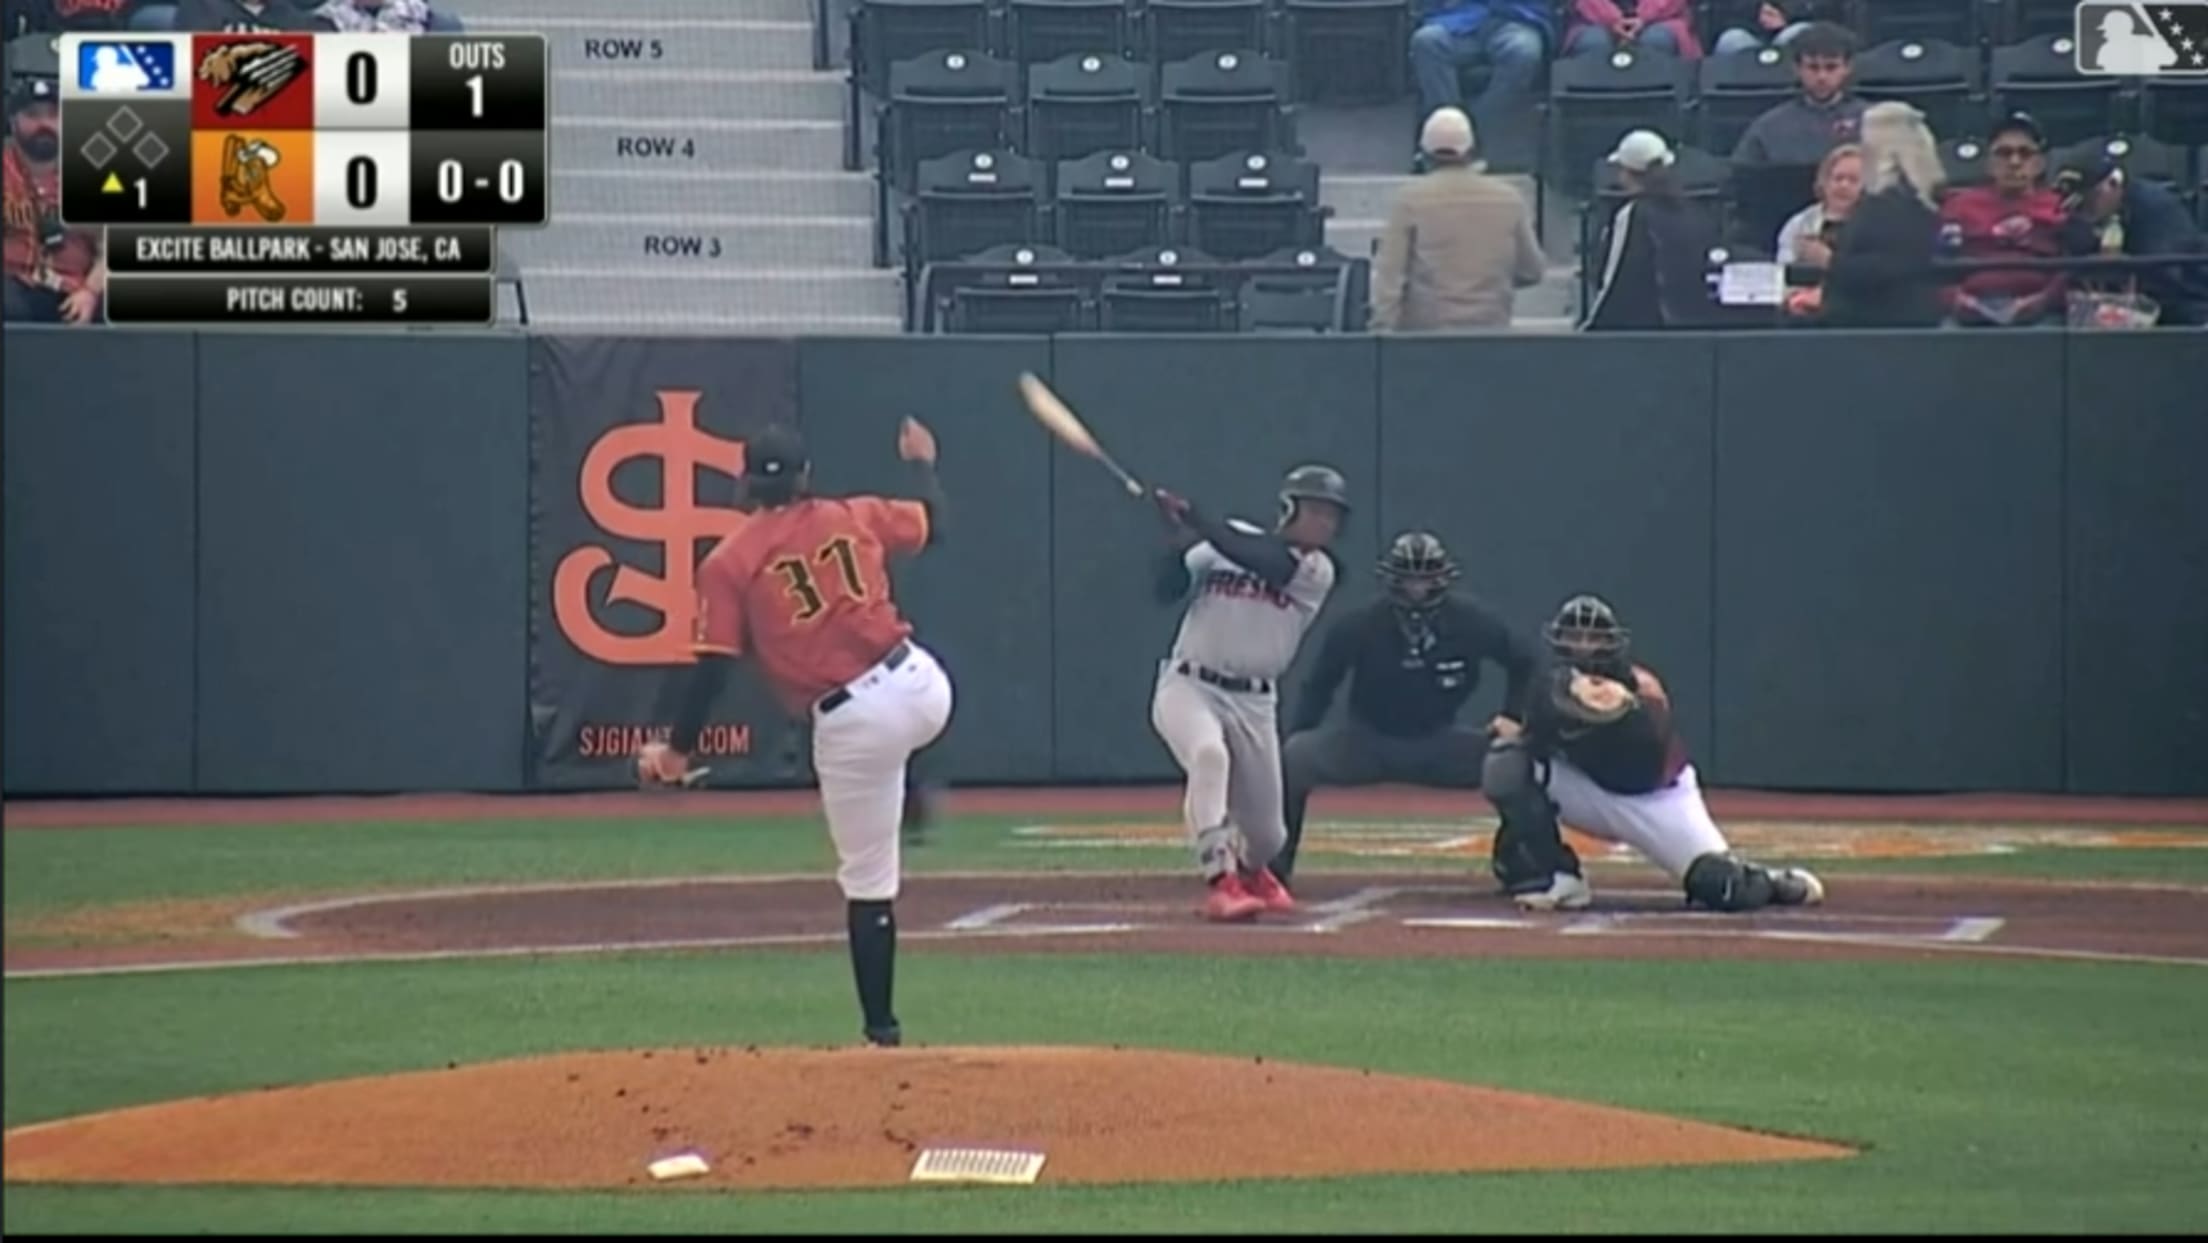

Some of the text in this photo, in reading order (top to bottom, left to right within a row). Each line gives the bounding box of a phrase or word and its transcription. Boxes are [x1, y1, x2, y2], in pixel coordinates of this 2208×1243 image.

[584, 39, 663, 60] ROW 5
[617, 137, 695, 158] ROW 4
[644, 235, 722, 258] ROW 3
